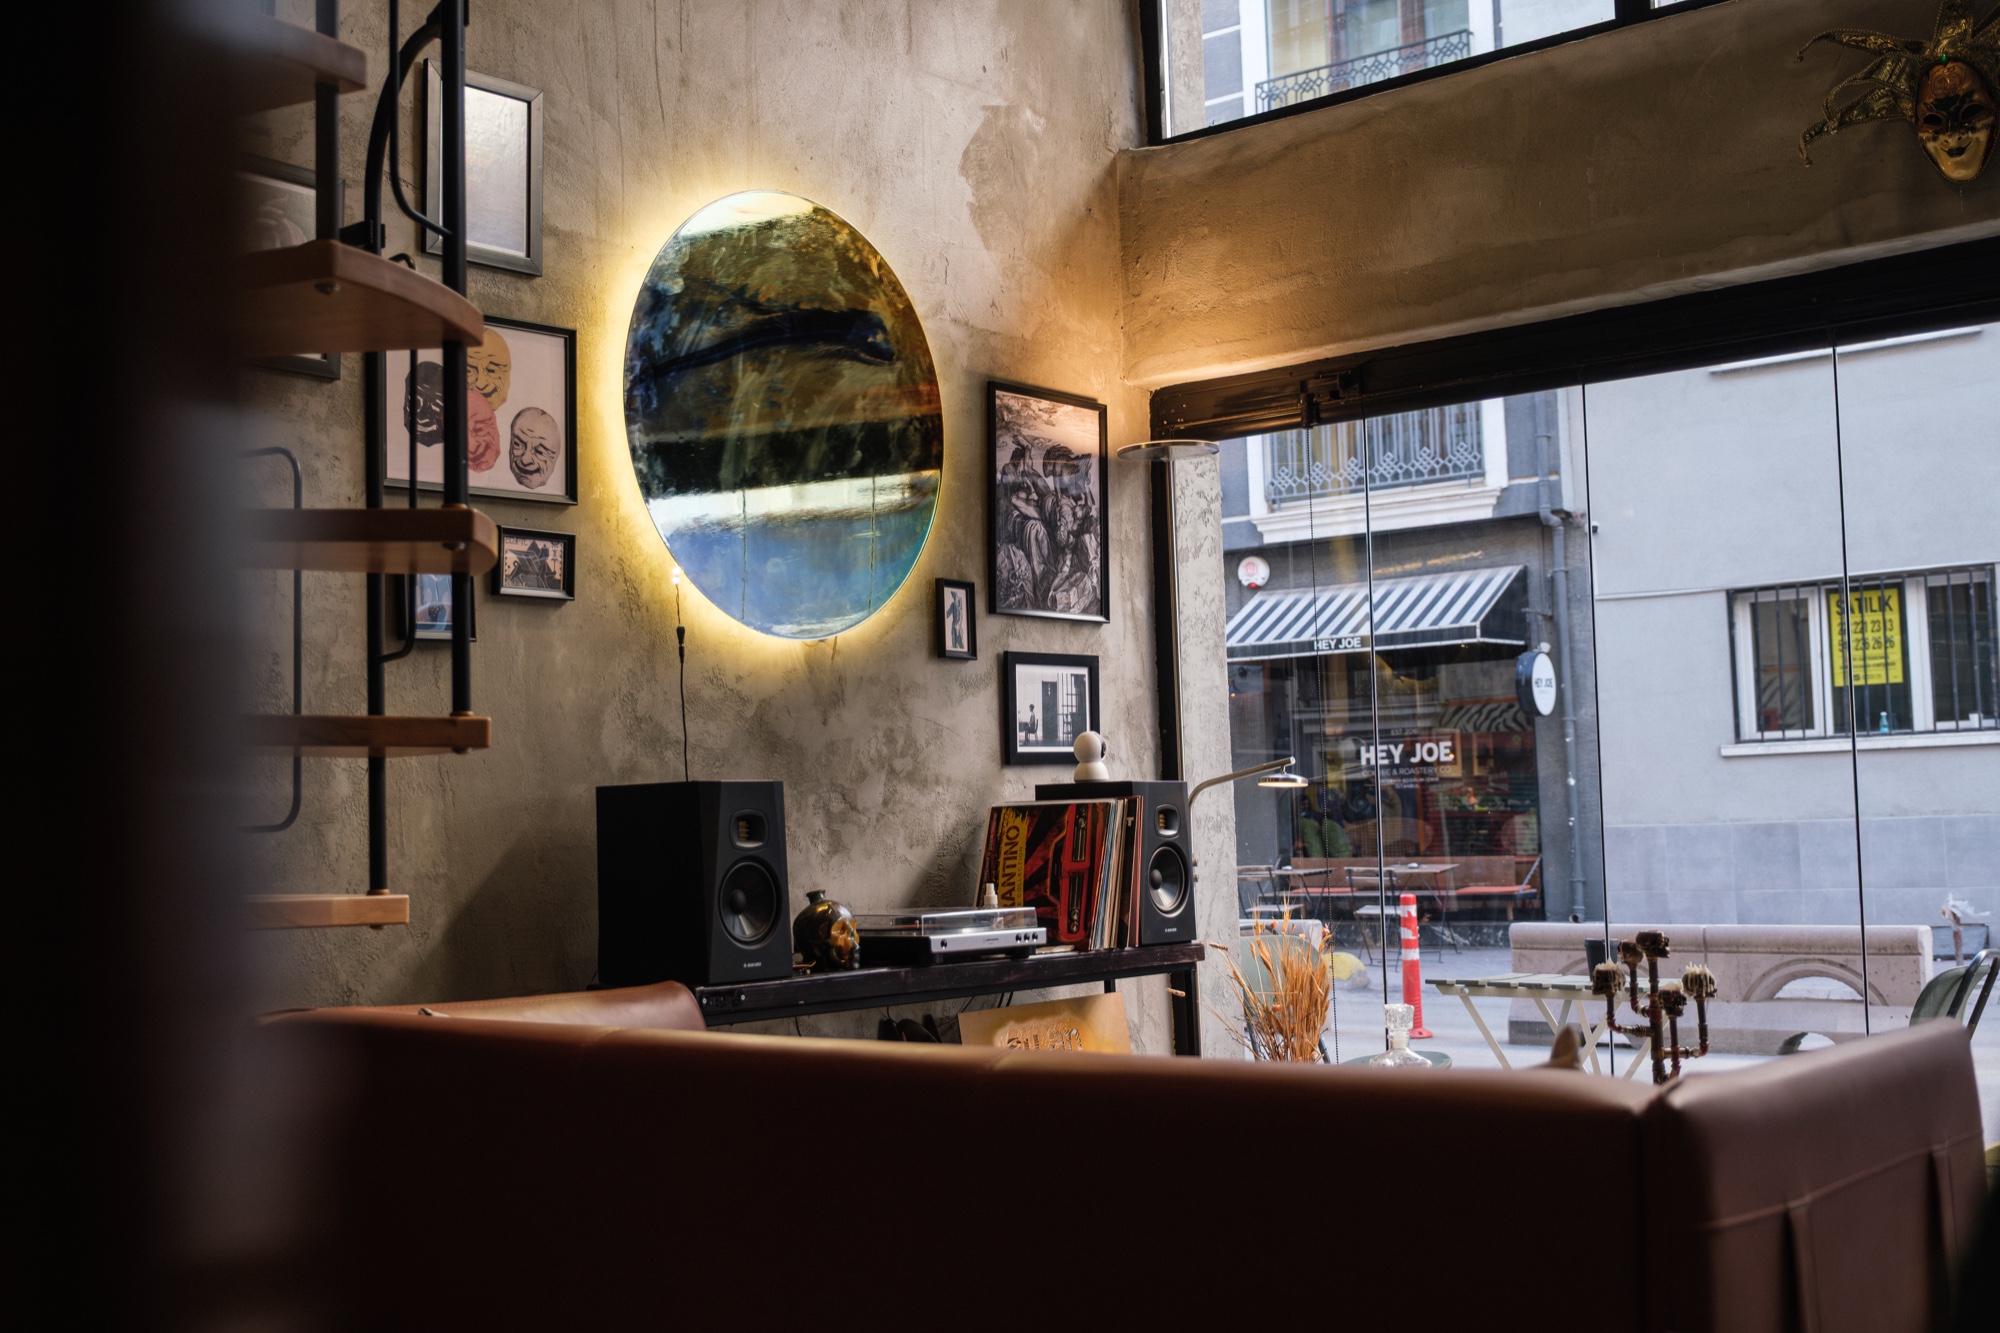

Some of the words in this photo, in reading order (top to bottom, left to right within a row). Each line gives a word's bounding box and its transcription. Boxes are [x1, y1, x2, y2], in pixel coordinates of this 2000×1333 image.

[1870, 619, 1881, 633] 23
[1314, 639, 1336, 650] HEY
[1338, 637, 1361, 649] JOE
[1360, 743, 1404, 766] HEY
[1409, 741, 1453, 764] JOE
[1362, 767, 1391, 777] COEE
[1399, 766, 1437, 776] ROASTERY
